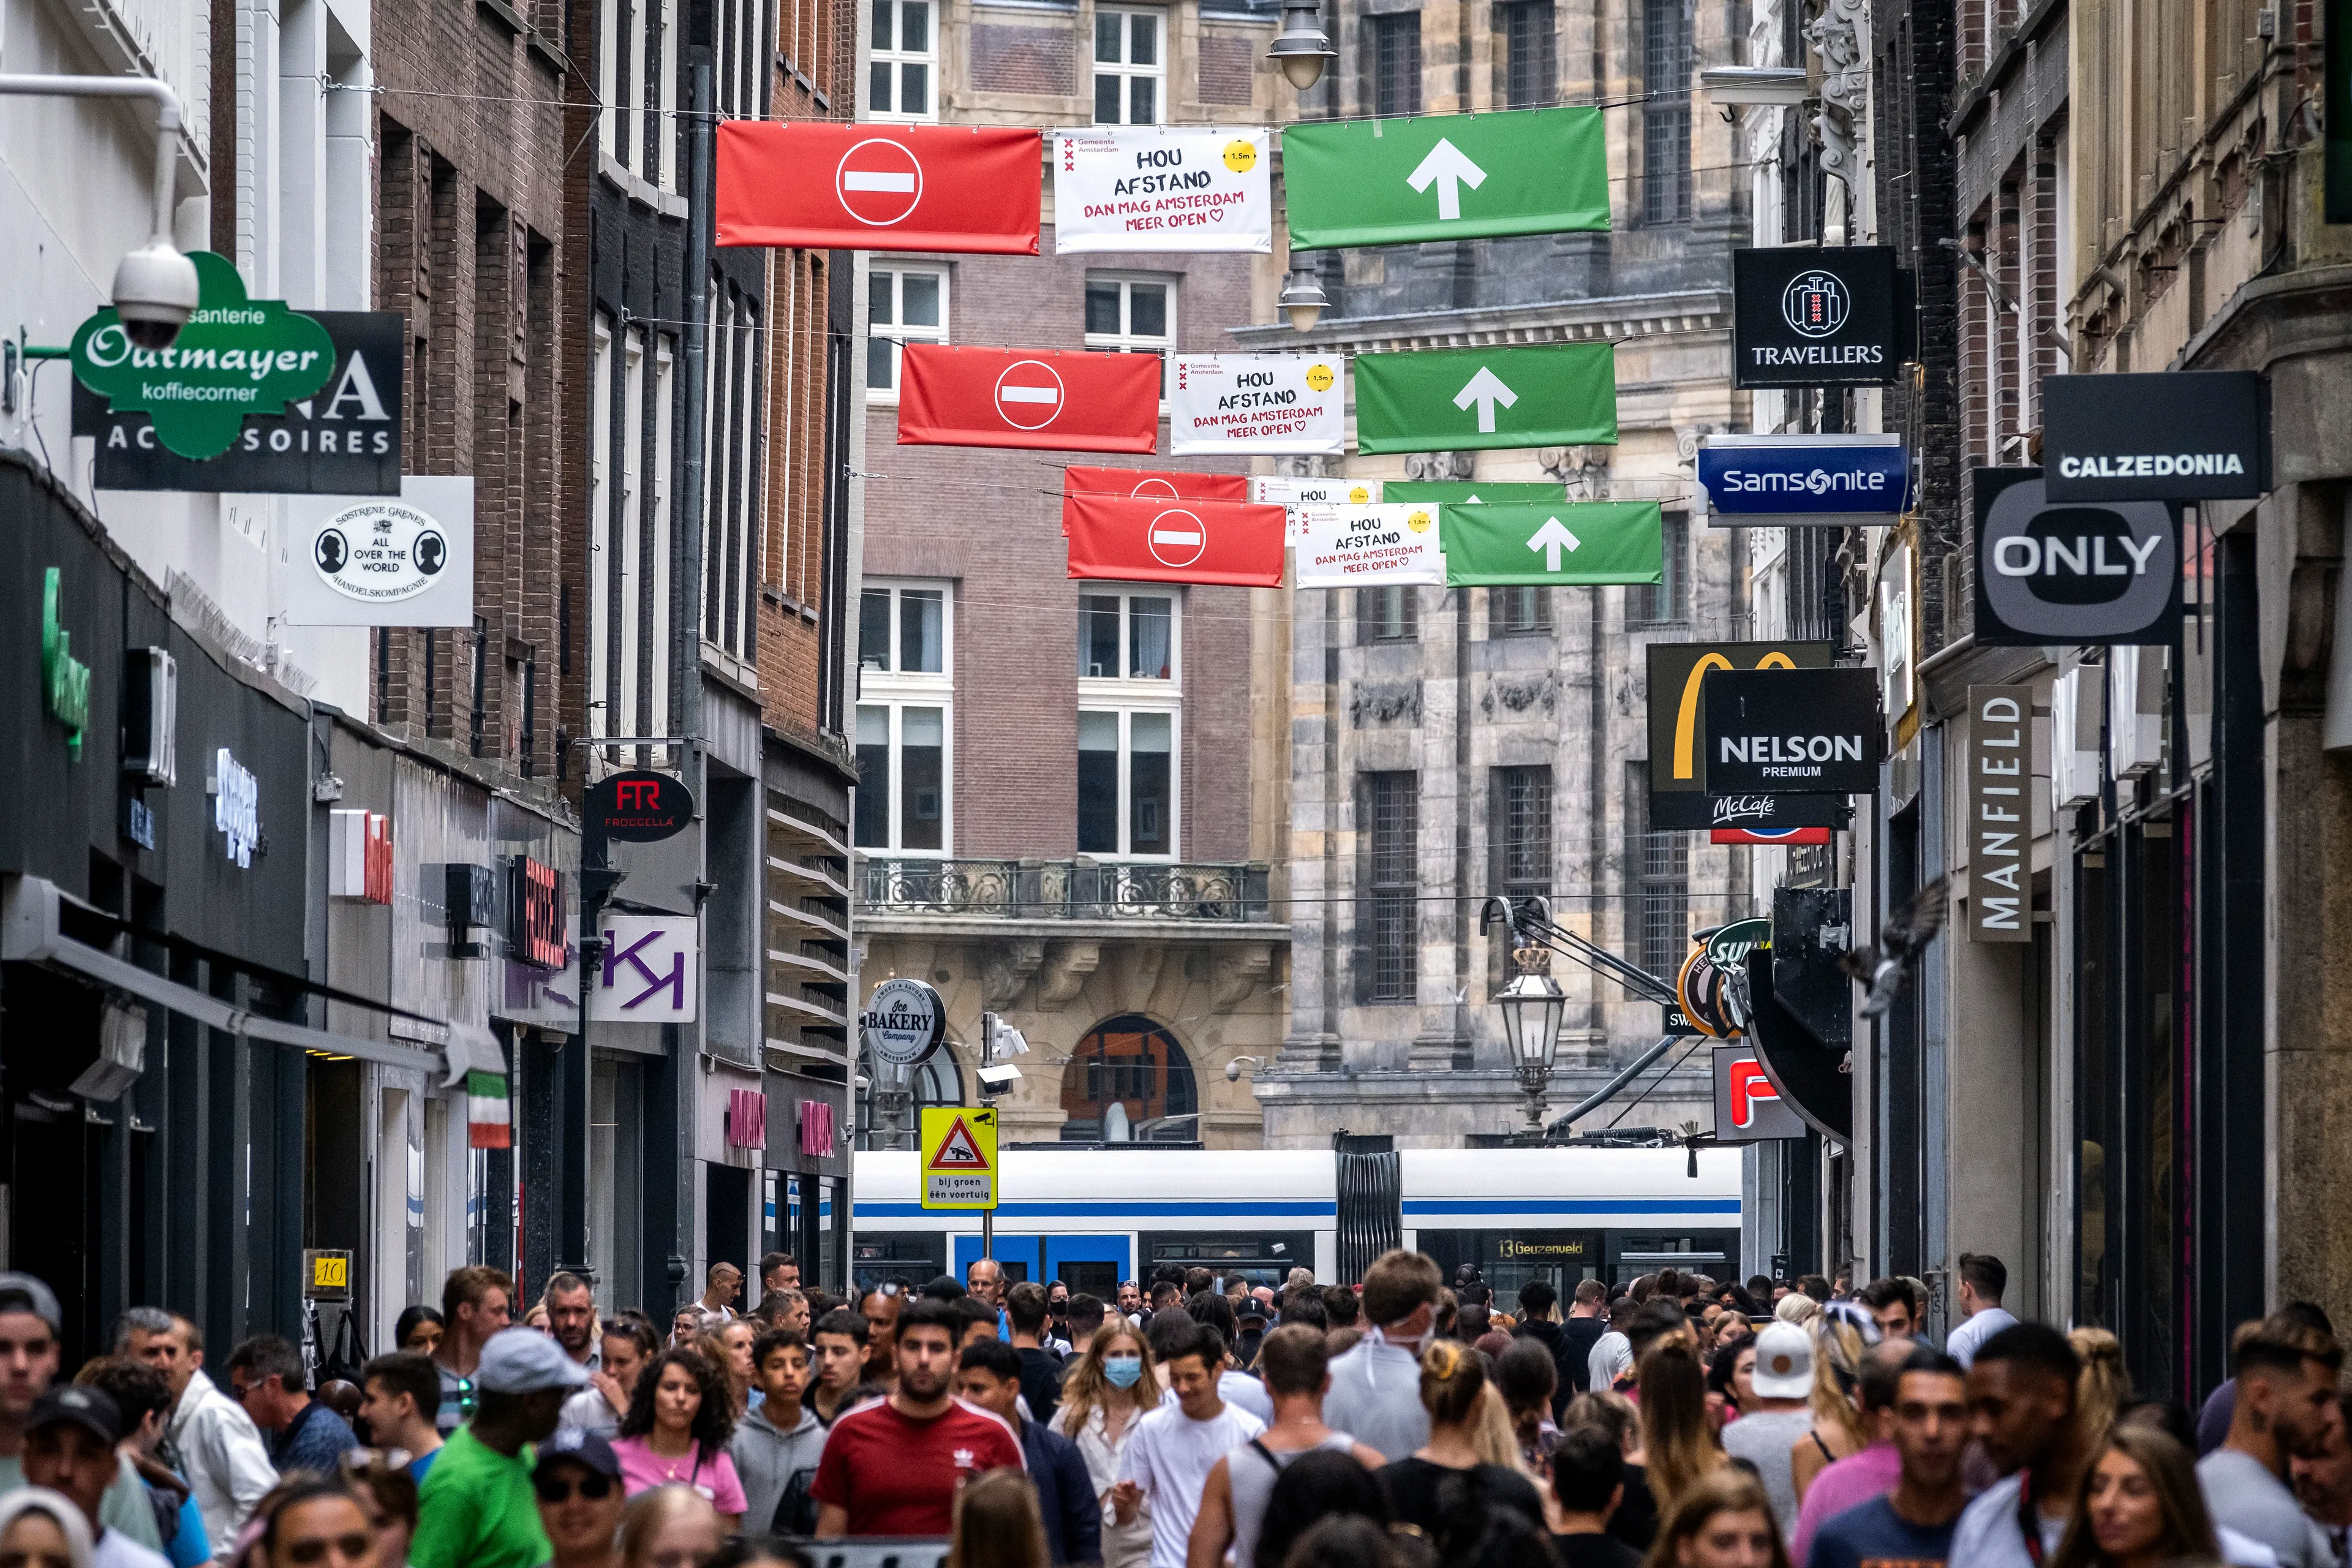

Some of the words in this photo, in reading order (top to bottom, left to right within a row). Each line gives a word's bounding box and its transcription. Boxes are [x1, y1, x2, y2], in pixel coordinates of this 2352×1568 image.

[1137, 148, 1182, 169] HOU
[1114, 170, 1212, 196] AFSTAND
[1084, 203, 1115, 218] DAN
[1118, 200, 1151, 215] MAG
[1155, 191, 1244, 211] AMSTERDAM
[1126, 216, 1164, 232] MEER
[1168, 213, 1207, 228] OPEN
[1752, 345, 1883, 365] TRAVELLERS
[1237, 372, 1273, 388] HOU
[143, 382, 259, 402] koffiecorner
[1218, 389, 1297, 410] AFSTAND
[1194, 416, 1218, 428] DAN
[1221, 413, 1248, 424] MAG
[1251, 406, 1323, 422] AMSTERDAM
[1227, 426, 1258, 438] MEER
[1261, 423, 1292, 435] OPEN
[2059, 453, 2244, 479] CALZEDONIA
[1724, 469, 1885, 495] Samsonite
[1301, 491, 1327, 501] HOU
[388, 507, 426, 527] GRENES
[1351, 518, 1381, 532] HOU
[372, 538, 389, 547] ALL
[1336, 532, 1400, 550] AFSTAND
[354, 550, 382, 559] OVER
[388, 551, 406, 560] THE
[1316, 555, 1336, 565] DAN
[1338, 553, 1360, 563] MAG
[1363, 545, 1423, 559] AMSTERDAM
[1993, 535, 2162, 578] ONLY
[362, 563, 399, 572] WORLD
[1343, 564, 1369, 574] MEER
[1371, 560, 1397, 570] OPEN
[333, 575, 428, 598] HANDELSKOMPAGNIE
[1721, 735, 1862, 763] NELSON
[1762, 767, 1822, 777] PREMIUM
[1713, 796, 1774, 823] McCafé
[1982, 697, 2021, 930] MANFIELD
[605, 818, 674, 827] FROCCELLA
[905, 984, 925, 1001] SAVORY
[867, 1012, 932, 1031] BAKERY
[882, 1030, 916, 1044] Company
[880, 1050, 917, 1061] AMSTERDAM
[939, 1178, 951, 1188] bij
[949, 1191, 989, 1200] voertuig
[1498, 1240, 1513, 1257] 13
[1515, 1240, 1583, 1254] Geuzenveld
